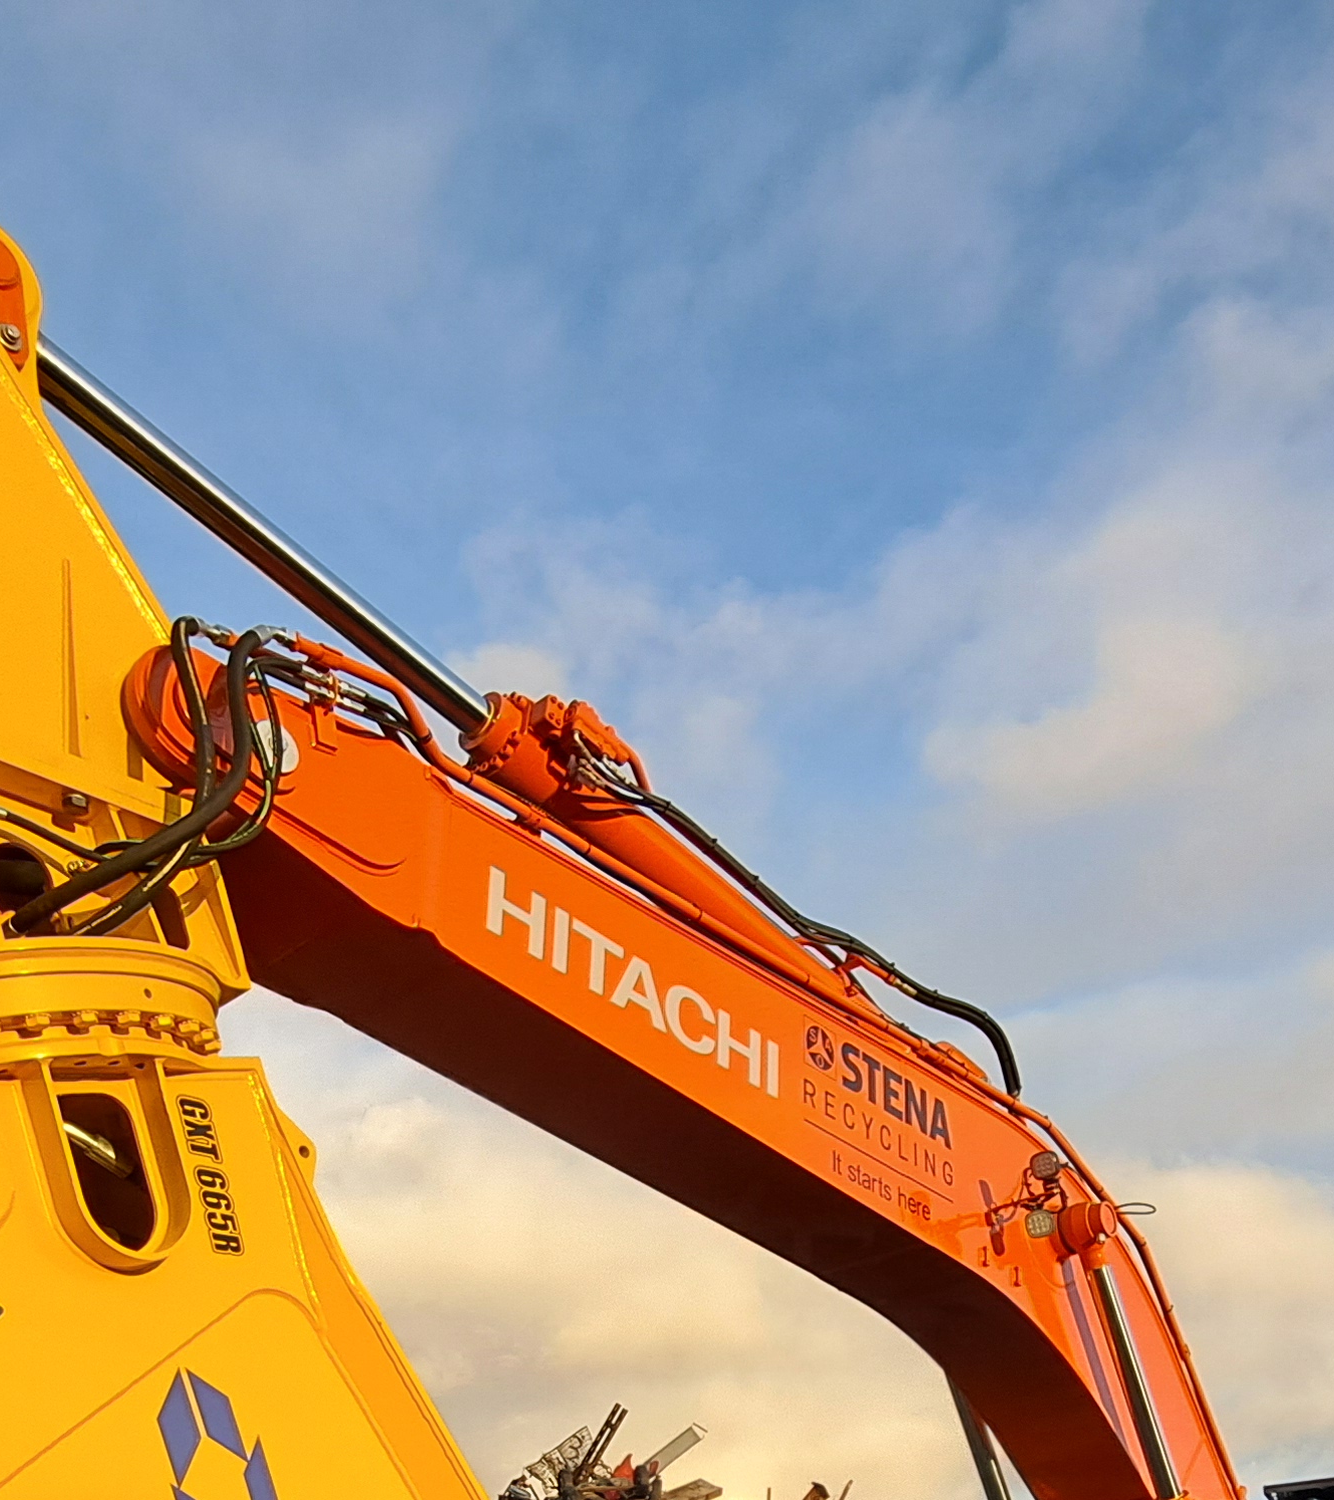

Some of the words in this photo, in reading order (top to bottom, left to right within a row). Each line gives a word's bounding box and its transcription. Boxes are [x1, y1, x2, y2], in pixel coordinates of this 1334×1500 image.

[485, 866, 781, 1097] HITACHI
[177, 1096, 221, 1163] GXT
[803, 1078, 954, 1187] RECYCLING
[841, 1042, 952, 1150] STENA
[195, 1167, 244, 1255] 665R
[832, 1150, 843, 1176] It
[847, 1164, 893, 1201] starts
[898, 1186, 932, 1221] here
